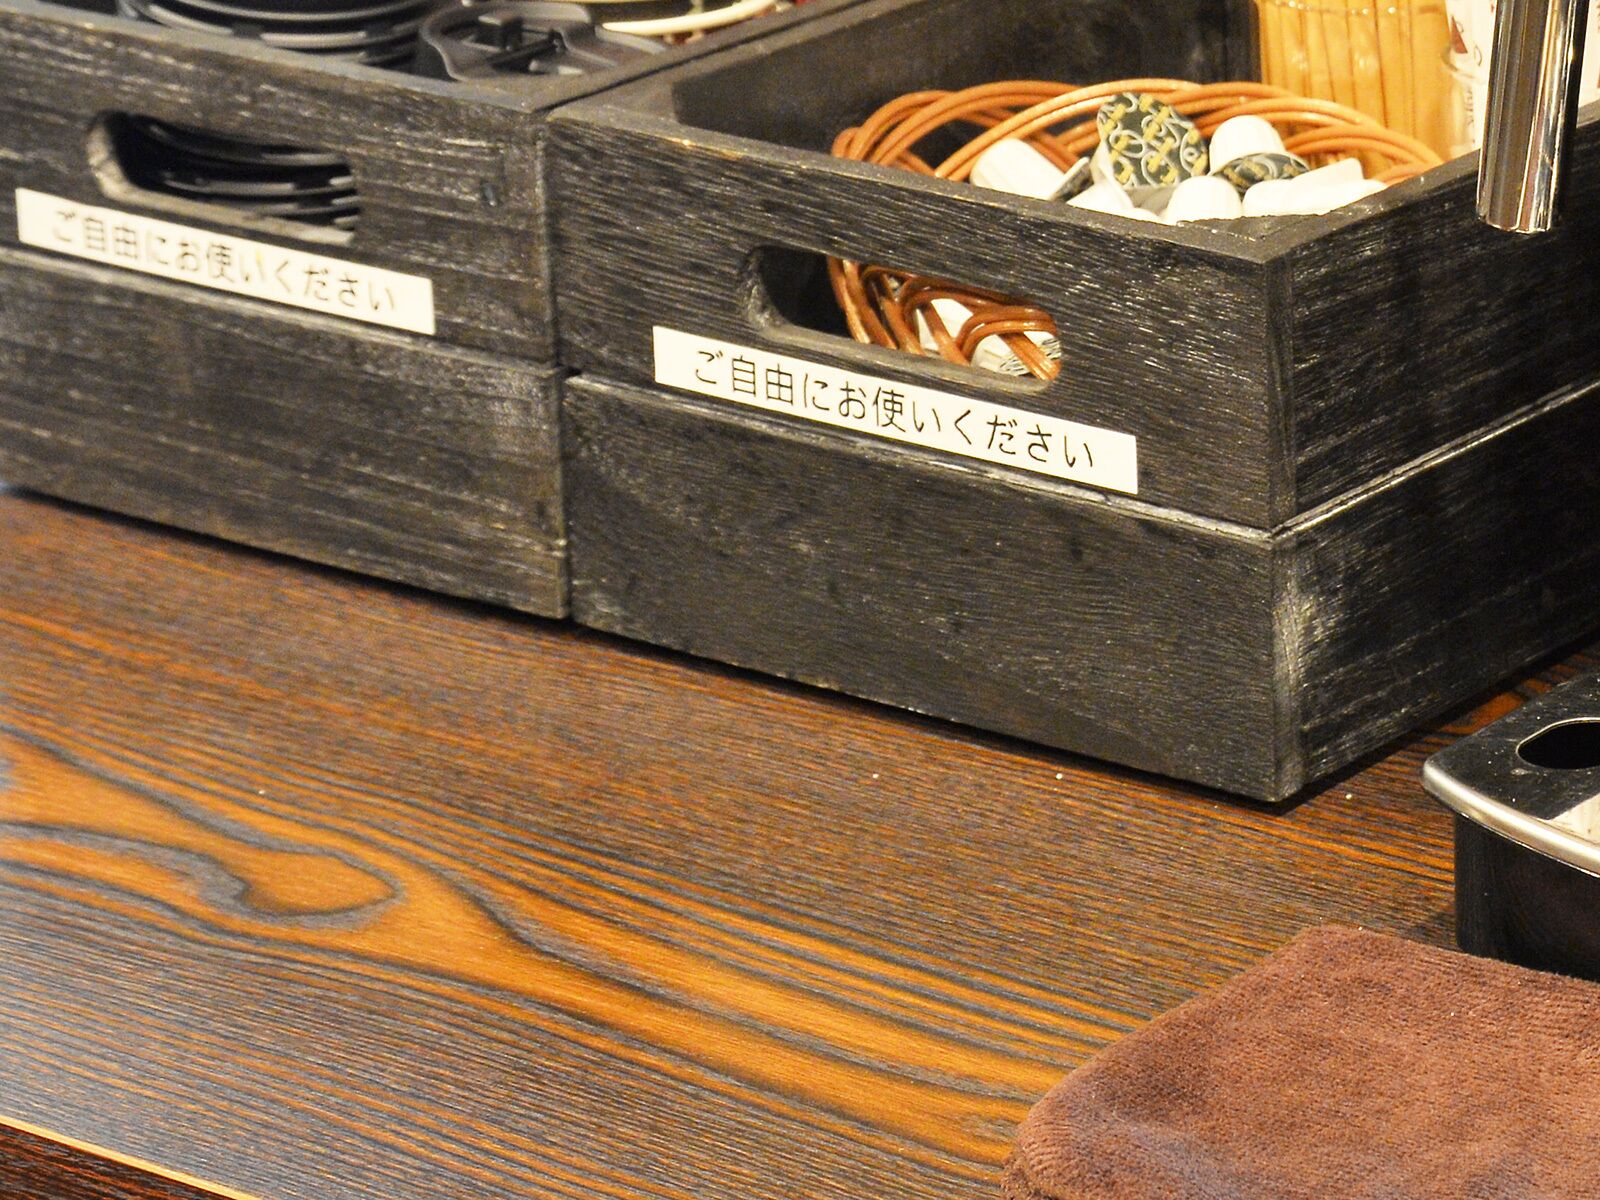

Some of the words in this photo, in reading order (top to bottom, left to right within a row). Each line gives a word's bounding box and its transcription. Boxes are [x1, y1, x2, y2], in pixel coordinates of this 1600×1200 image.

[51, 206, 398, 313] ご自由にお使いください
[691, 346, 1095, 469] ご自由にお使いください
